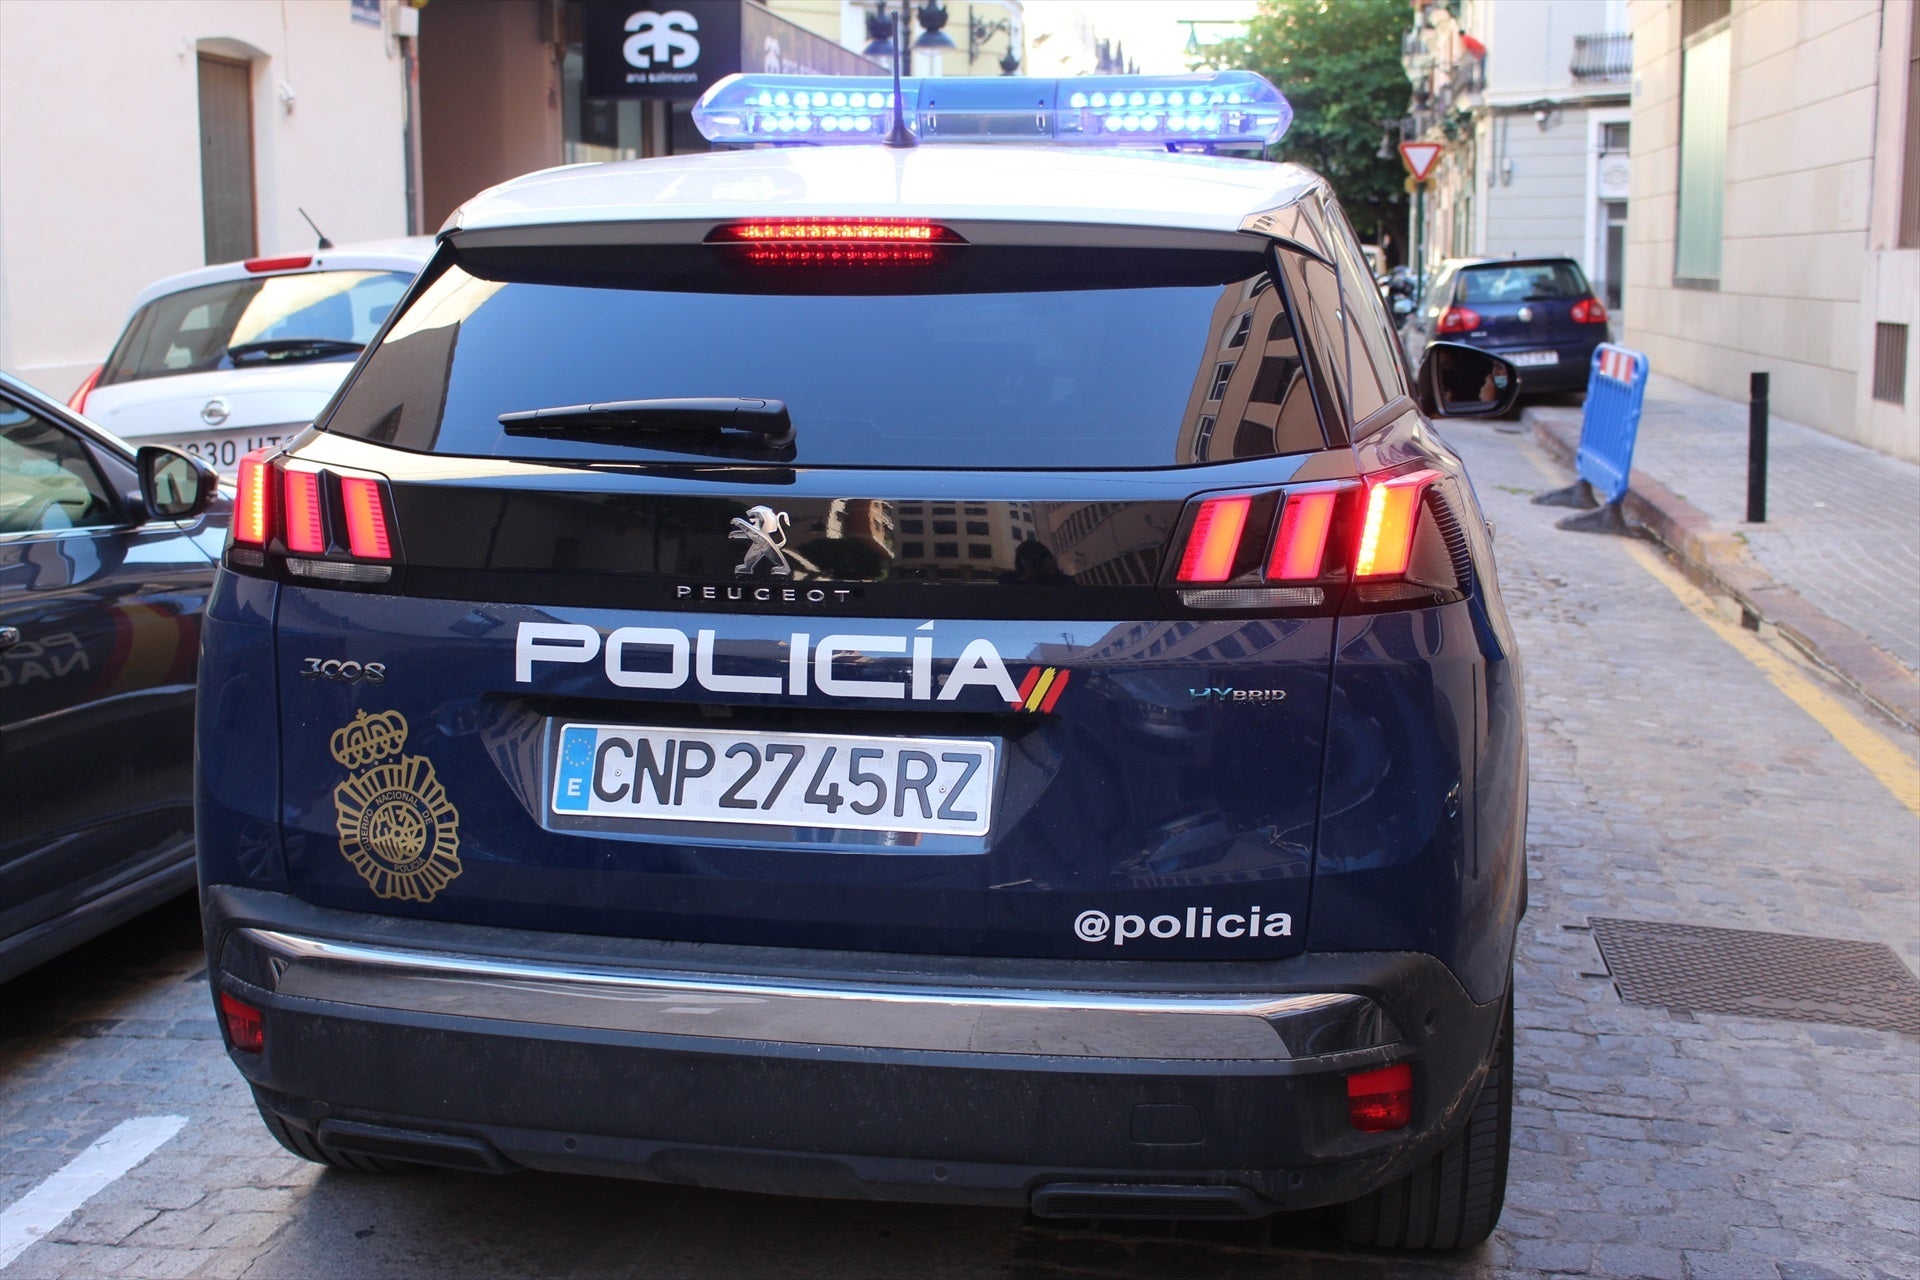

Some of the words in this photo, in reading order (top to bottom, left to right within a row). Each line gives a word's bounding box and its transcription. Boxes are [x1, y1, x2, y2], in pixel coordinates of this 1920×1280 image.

[174, 440, 235, 466] 30
[677, 585, 850, 602] PEUGEOT
[300, 657, 386, 683] 3008
[515, 619, 1023, 703] POLICÍA
[1188, 687, 1287, 701] HYBRID
[567, 777, 582, 797] E
[592, 736, 982, 822] CNP2745RZ
[360, 808, 374, 852] CUERPO
[375, 791, 418, 808] NACIONAL
[421, 810, 433, 825] DE
[1074, 905, 1292, 946] @policia
